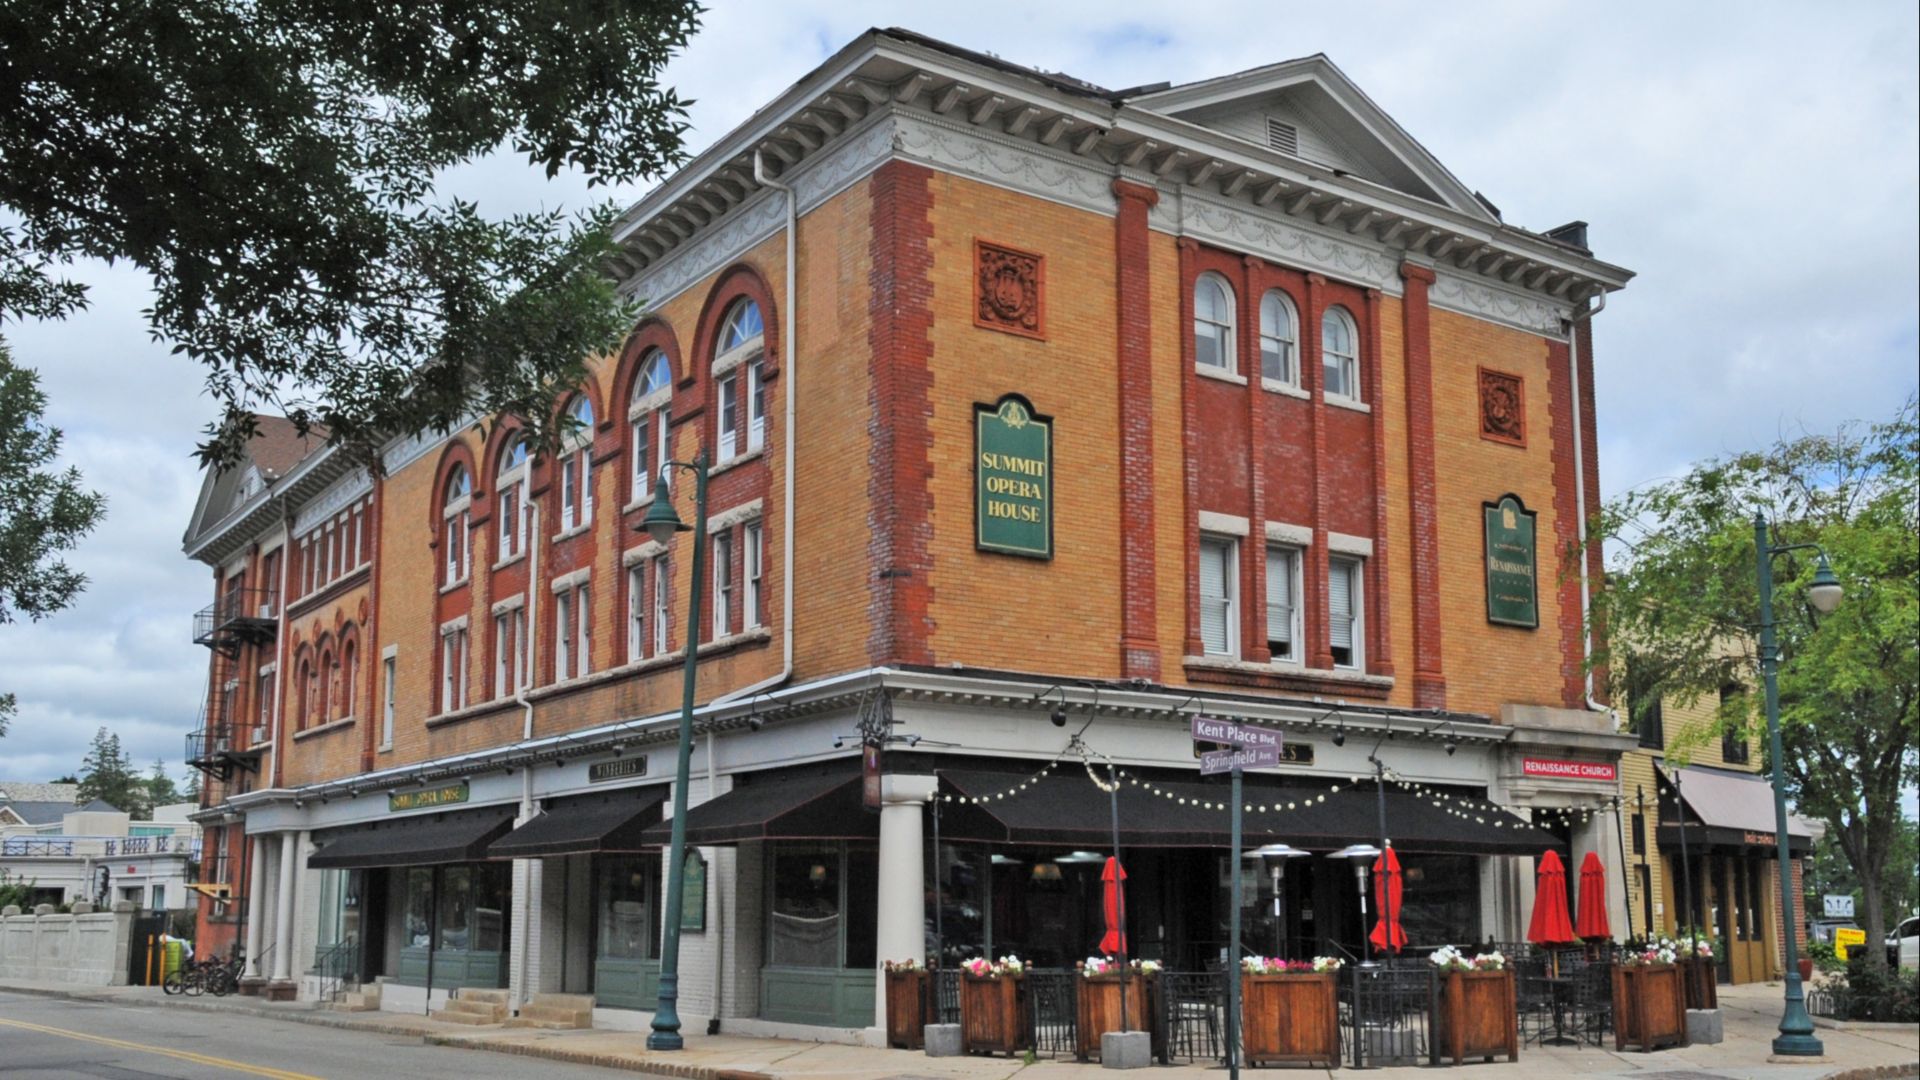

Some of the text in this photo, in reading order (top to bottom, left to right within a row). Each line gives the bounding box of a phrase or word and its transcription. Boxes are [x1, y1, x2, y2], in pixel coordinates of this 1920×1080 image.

[982, 452, 1044, 477] SUMMIT
[987, 477, 1042, 499] OPERA
[988, 500, 1040, 523] HOUSE
[1197, 721, 1224, 738] Kent
[1227, 726, 1257, 743] Place
[1205, 749, 1256, 772] Springfield
[1525, 761, 1612, 777] RENAISSANCE CHURCH
